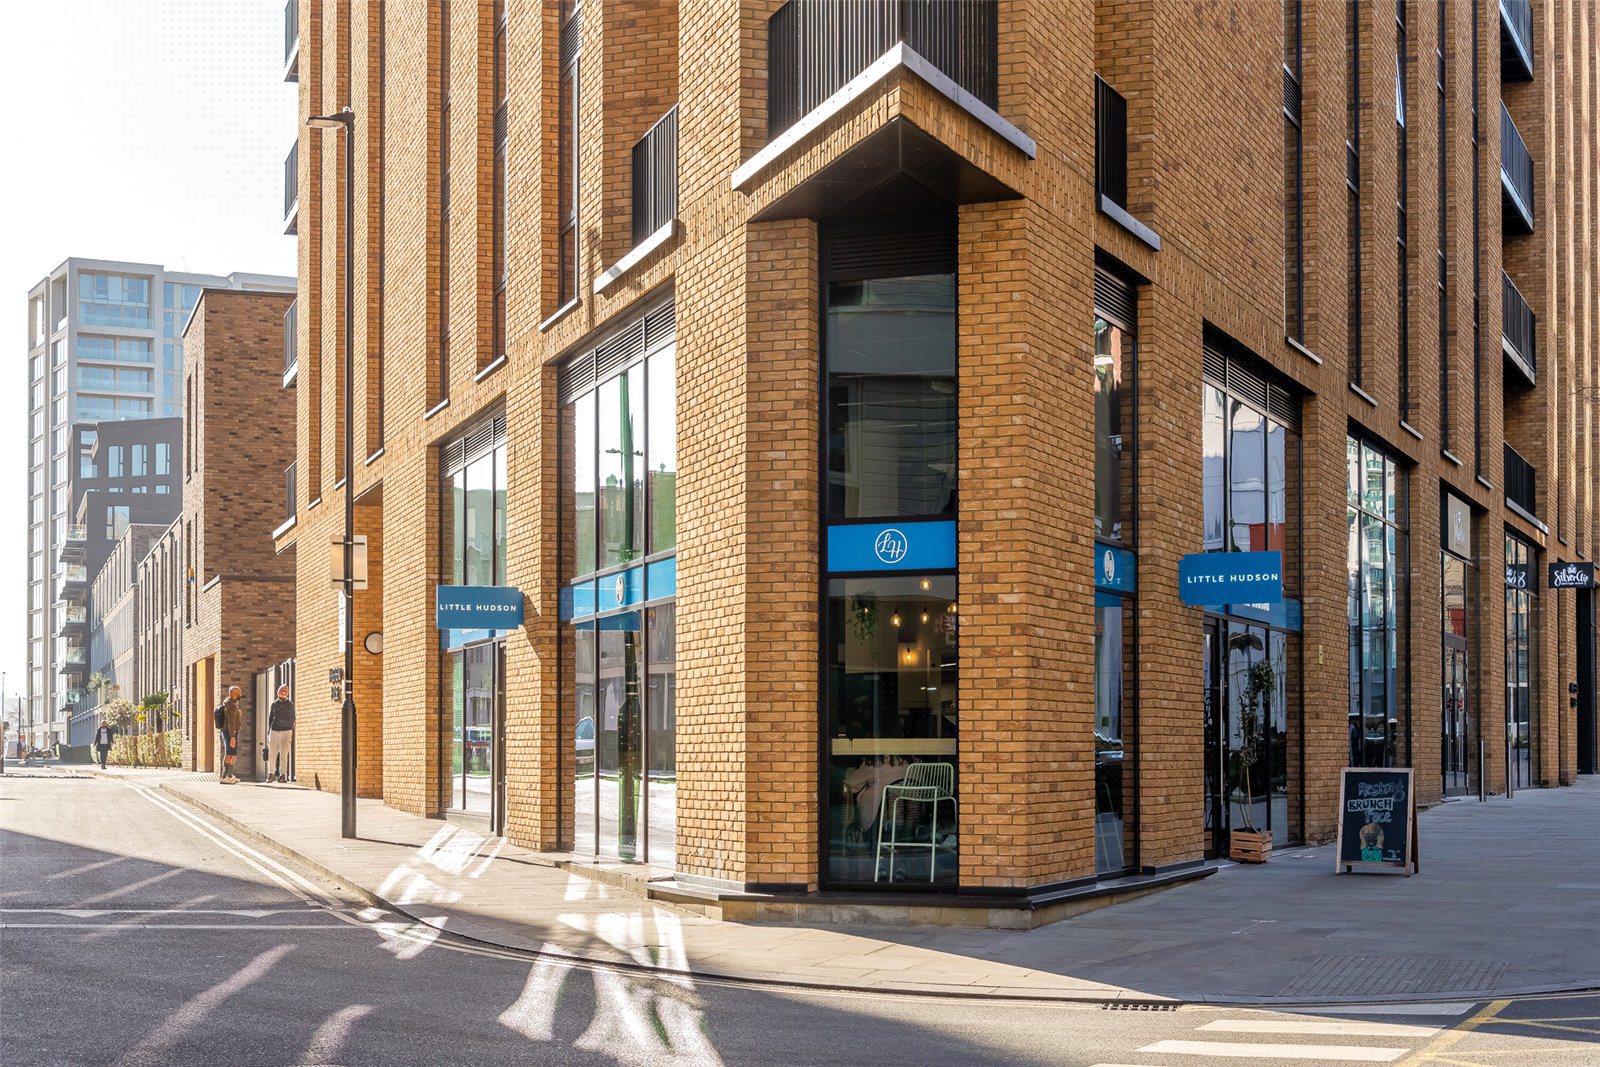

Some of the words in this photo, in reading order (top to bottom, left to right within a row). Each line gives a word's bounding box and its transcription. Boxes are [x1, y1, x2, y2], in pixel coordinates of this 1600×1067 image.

[877, 532, 905, 559] LH
[1187, 575, 1225, 584] LITTLE
[1230, 573, 1279, 583] HUDSON
[439, 603, 472, 611] LITTLE
[476, 604, 517, 612] HUDSON
[1348, 798, 1393, 811] BRUNCH
